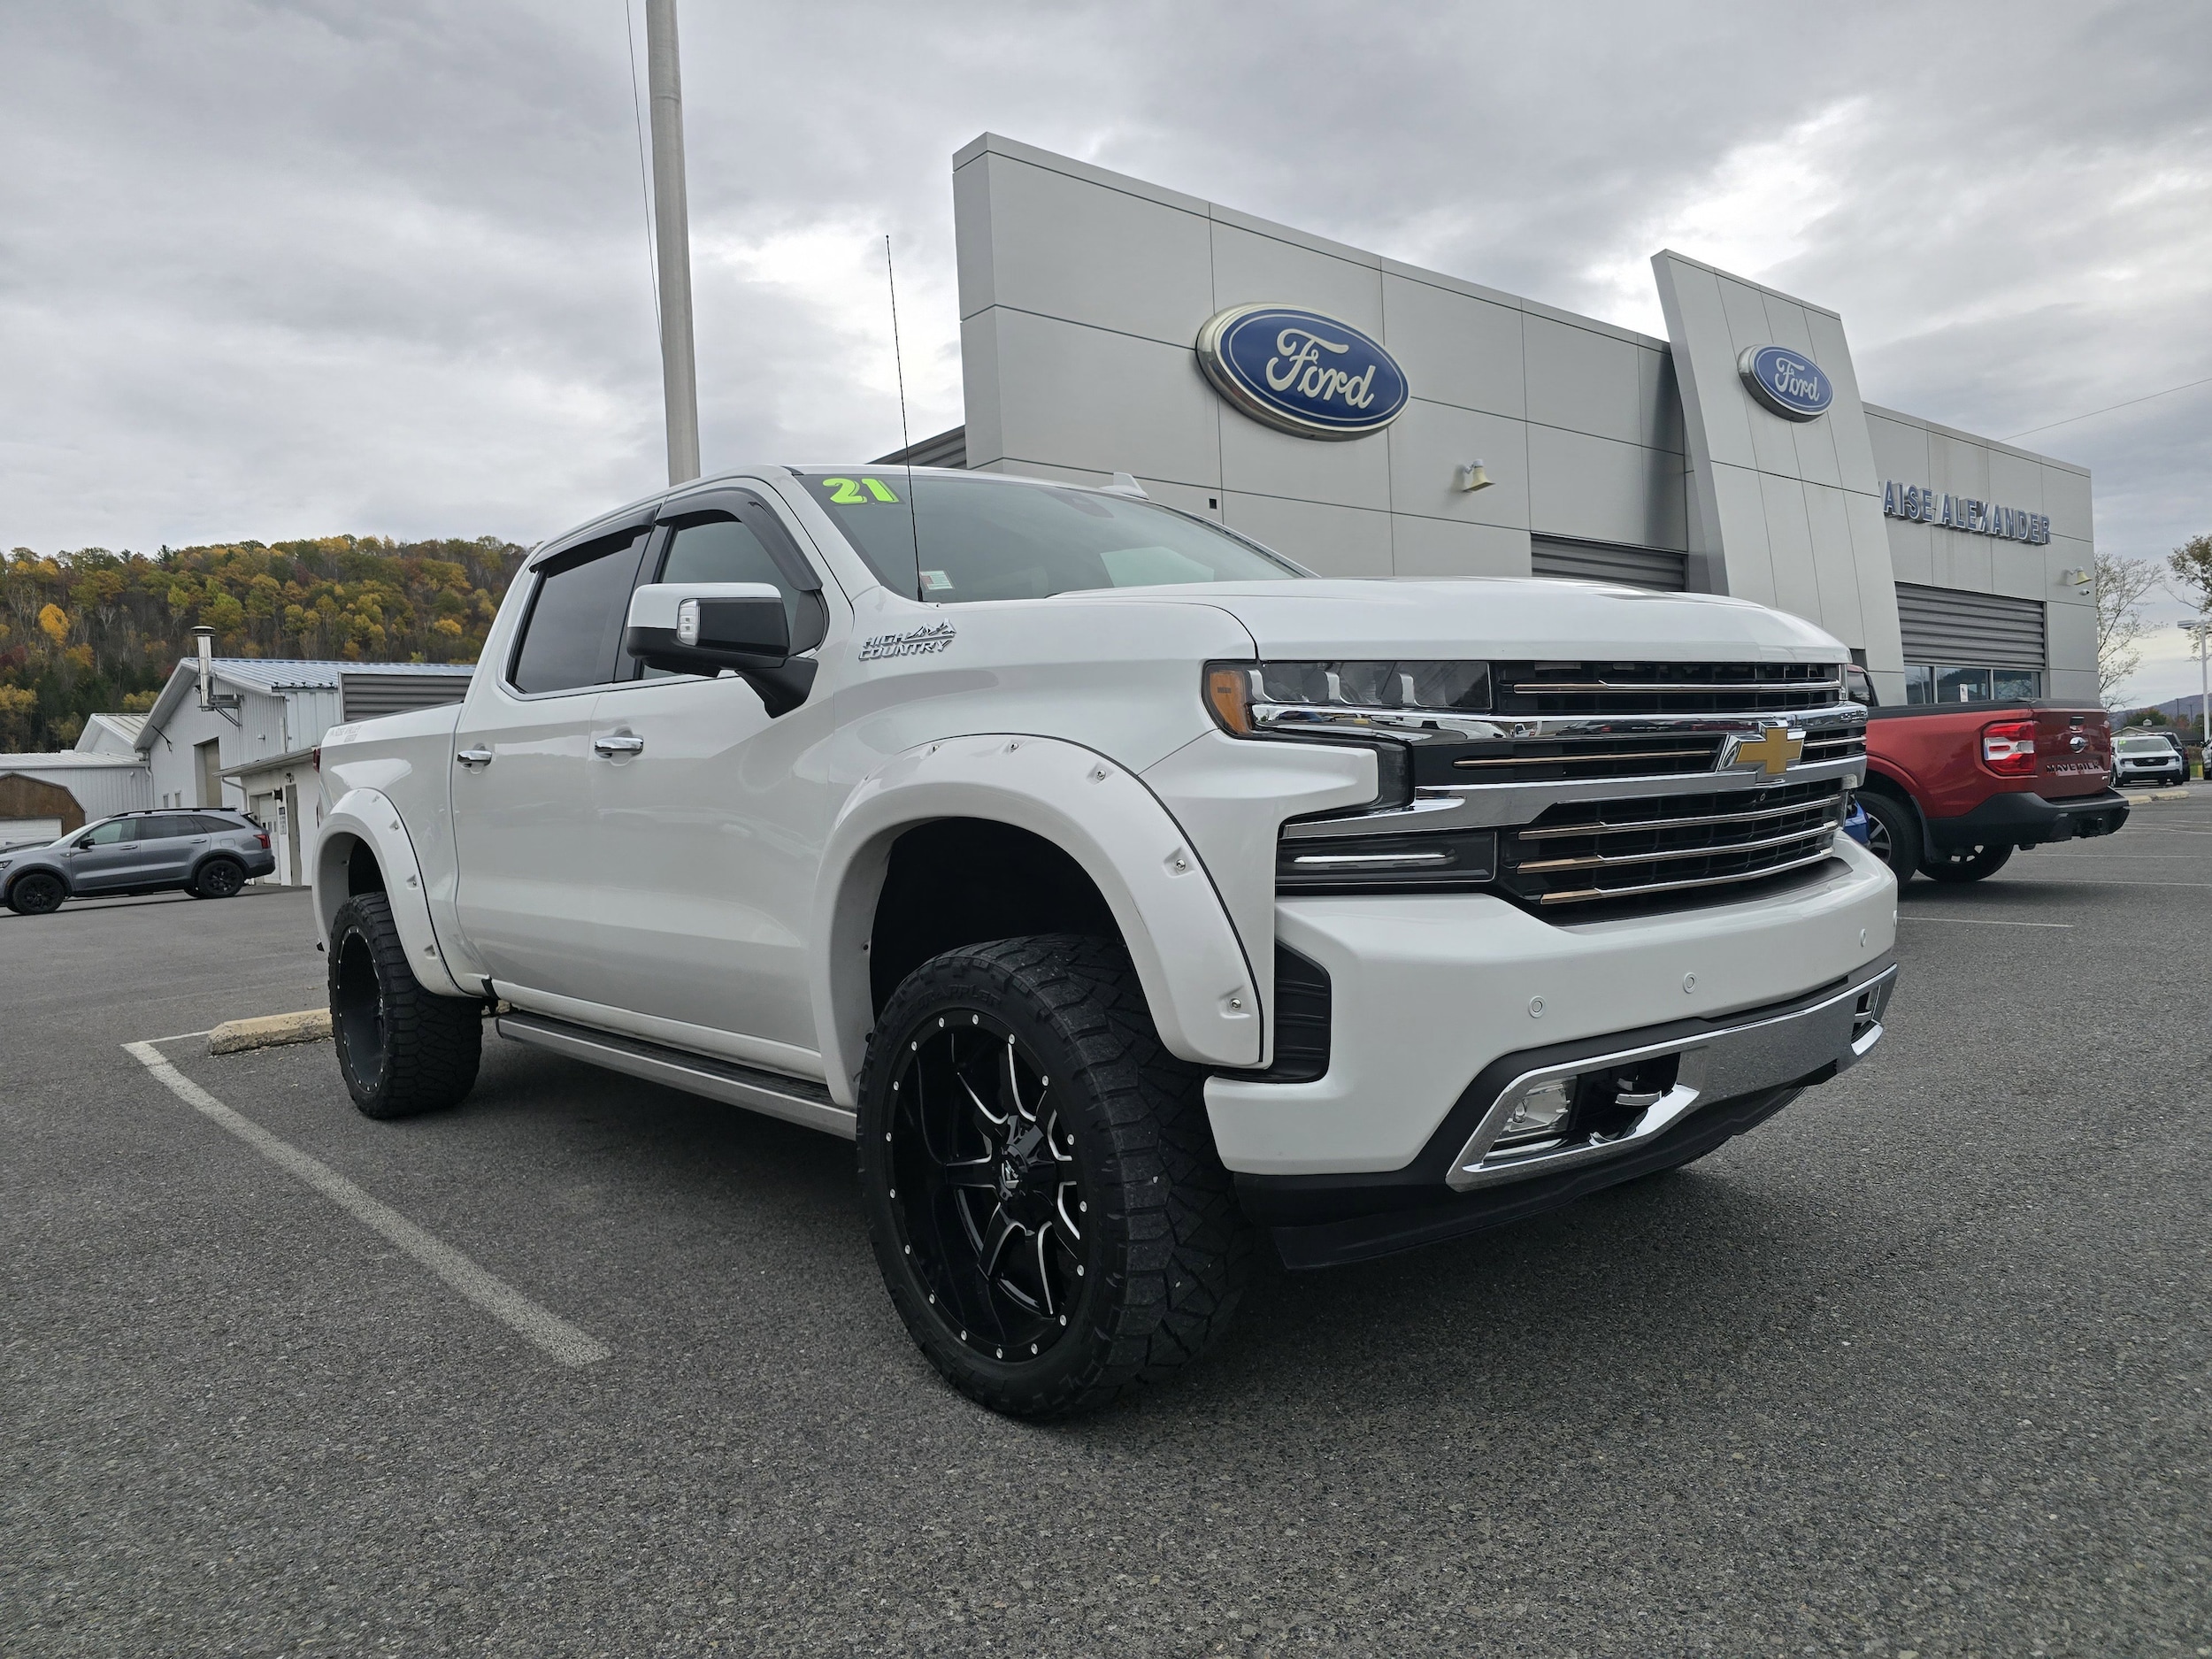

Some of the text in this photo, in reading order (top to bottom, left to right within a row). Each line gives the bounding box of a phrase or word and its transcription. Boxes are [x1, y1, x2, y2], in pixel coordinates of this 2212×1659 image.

[1265, 328, 1376, 410] Ford
[1774, 357, 1820, 402] Ford
[822, 477, 900, 505] 21
[1882, 480, 2052, 545] AISE ALEXANDER
[857, 639, 953, 662] COUNTRY
[862, 632, 905, 649] HIGH
